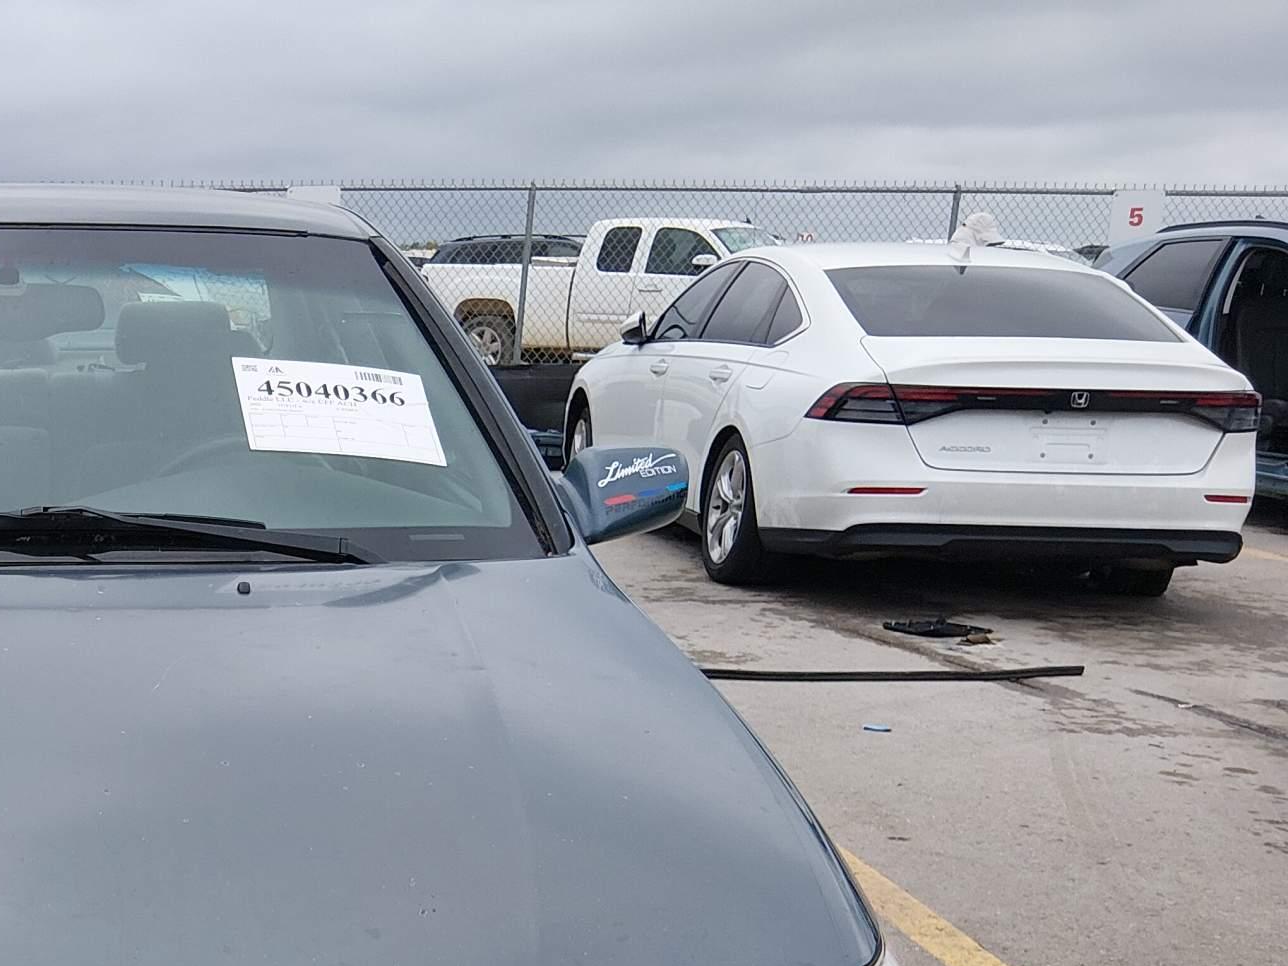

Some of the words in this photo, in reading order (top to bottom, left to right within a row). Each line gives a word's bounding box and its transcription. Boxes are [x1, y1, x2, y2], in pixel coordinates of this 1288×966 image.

[1128, 207, 1144, 227] 5
[257, 379, 406, 407] 45040366
[597, 452, 677, 488] Limited
[639, 464, 677, 478] EDITION
